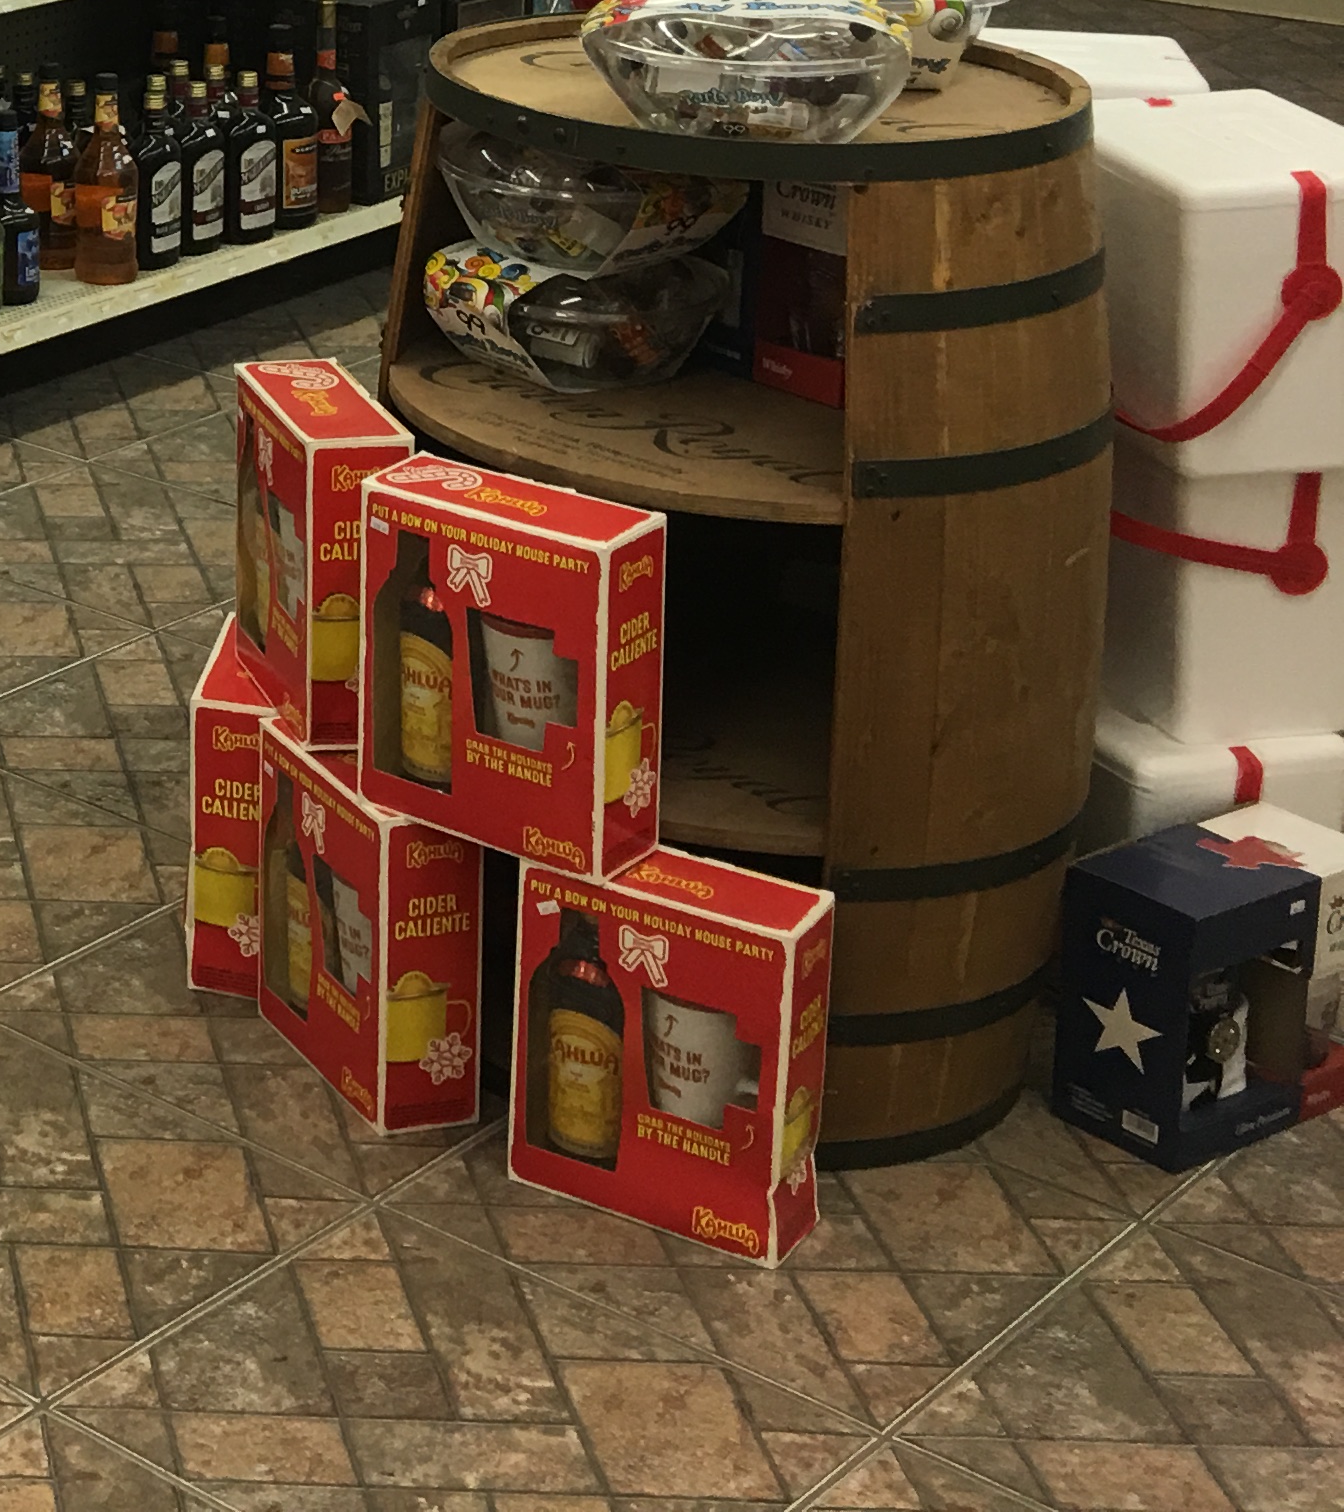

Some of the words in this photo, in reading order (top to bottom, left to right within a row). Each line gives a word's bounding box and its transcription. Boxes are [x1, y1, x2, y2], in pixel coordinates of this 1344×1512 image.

[456, 309, 486, 336] 99
[372, 502, 390, 519] PUT
[391, 509, 399, 523] A
[401, 510, 422, 529] BOW
[424, 517, 439, 533] ON
[440, 522, 468, 542] YOUR
[470, 529, 515, 554] HOLIDAY
[515, 544, 551, 565] HOUSE
[552, 553, 591, 575] PARTY
[619, 611, 650, 645] CIDER
[610, 627, 658, 672] CALIENTE
[536, 680, 553, 693] IN
[520, 692, 561, 711] MUG?
[466, 739, 490, 753] GRAB
[492, 745, 508, 758] THE
[466, 749, 482, 765] BY
[484, 755, 506, 773] THE
[507, 761, 553, 787] HANDLE
[201, 797, 260, 821] CALIEN
[408, 893, 457, 915] CIDER
[394, 912, 471, 941] CALIENTE
[530, 879, 551, 896] PUT
[554, 886, 562, 900] A
[564, 888, 590, 911] BOW
[592, 896, 607, 915] ON
[611, 902, 640, 924] YOUR
[643, 912, 693, 938] HOLIDAY
[694, 928, 733, 952] HOUSE
[735, 939, 775, 962] PARTY
[1096, 928, 1160, 973] Crown
[687, 1051, 703, 1066] IN
[669, 1063, 711, 1085] MUG?
[666, 1120, 684, 1135] THE
[637, 1123, 654, 1141] BY
[656, 1130, 679, 1150] THE
[682, 1138, 732, 1167] HANDLE
